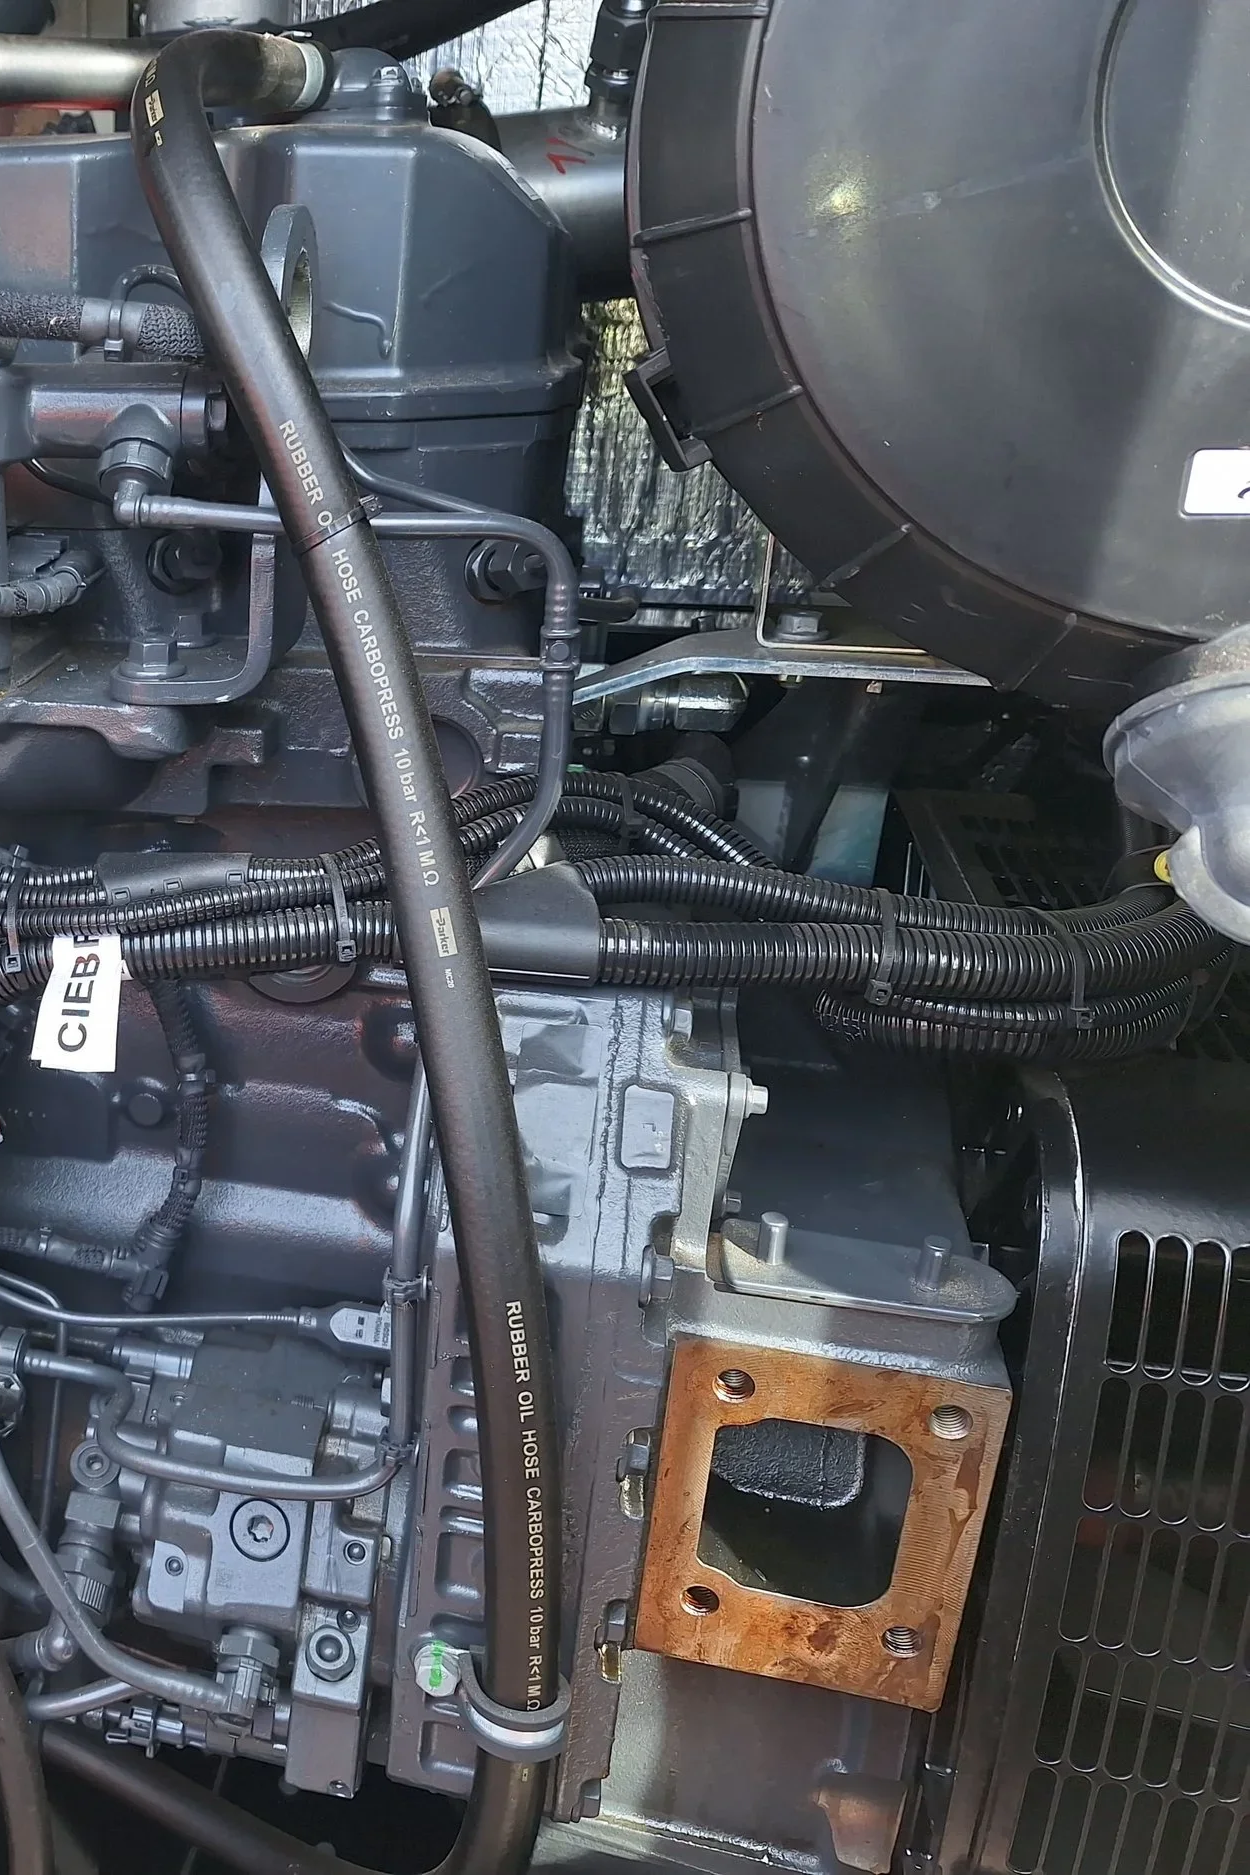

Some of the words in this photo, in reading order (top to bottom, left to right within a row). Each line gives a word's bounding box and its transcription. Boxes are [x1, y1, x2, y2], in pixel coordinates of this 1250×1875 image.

[279, 419, 324, 505] RUBBER
[332, 549, 363, 604] HOSE
[353, 609, 404, 740] CARBOPRESS
[505, 1301, 531, 1384] RUBBER
[517, 1390, 534, 1423] OIL
[522, 1429, 540, 1479] HOSE
[526, 1486, 545, 1600] CARBOPRESS
